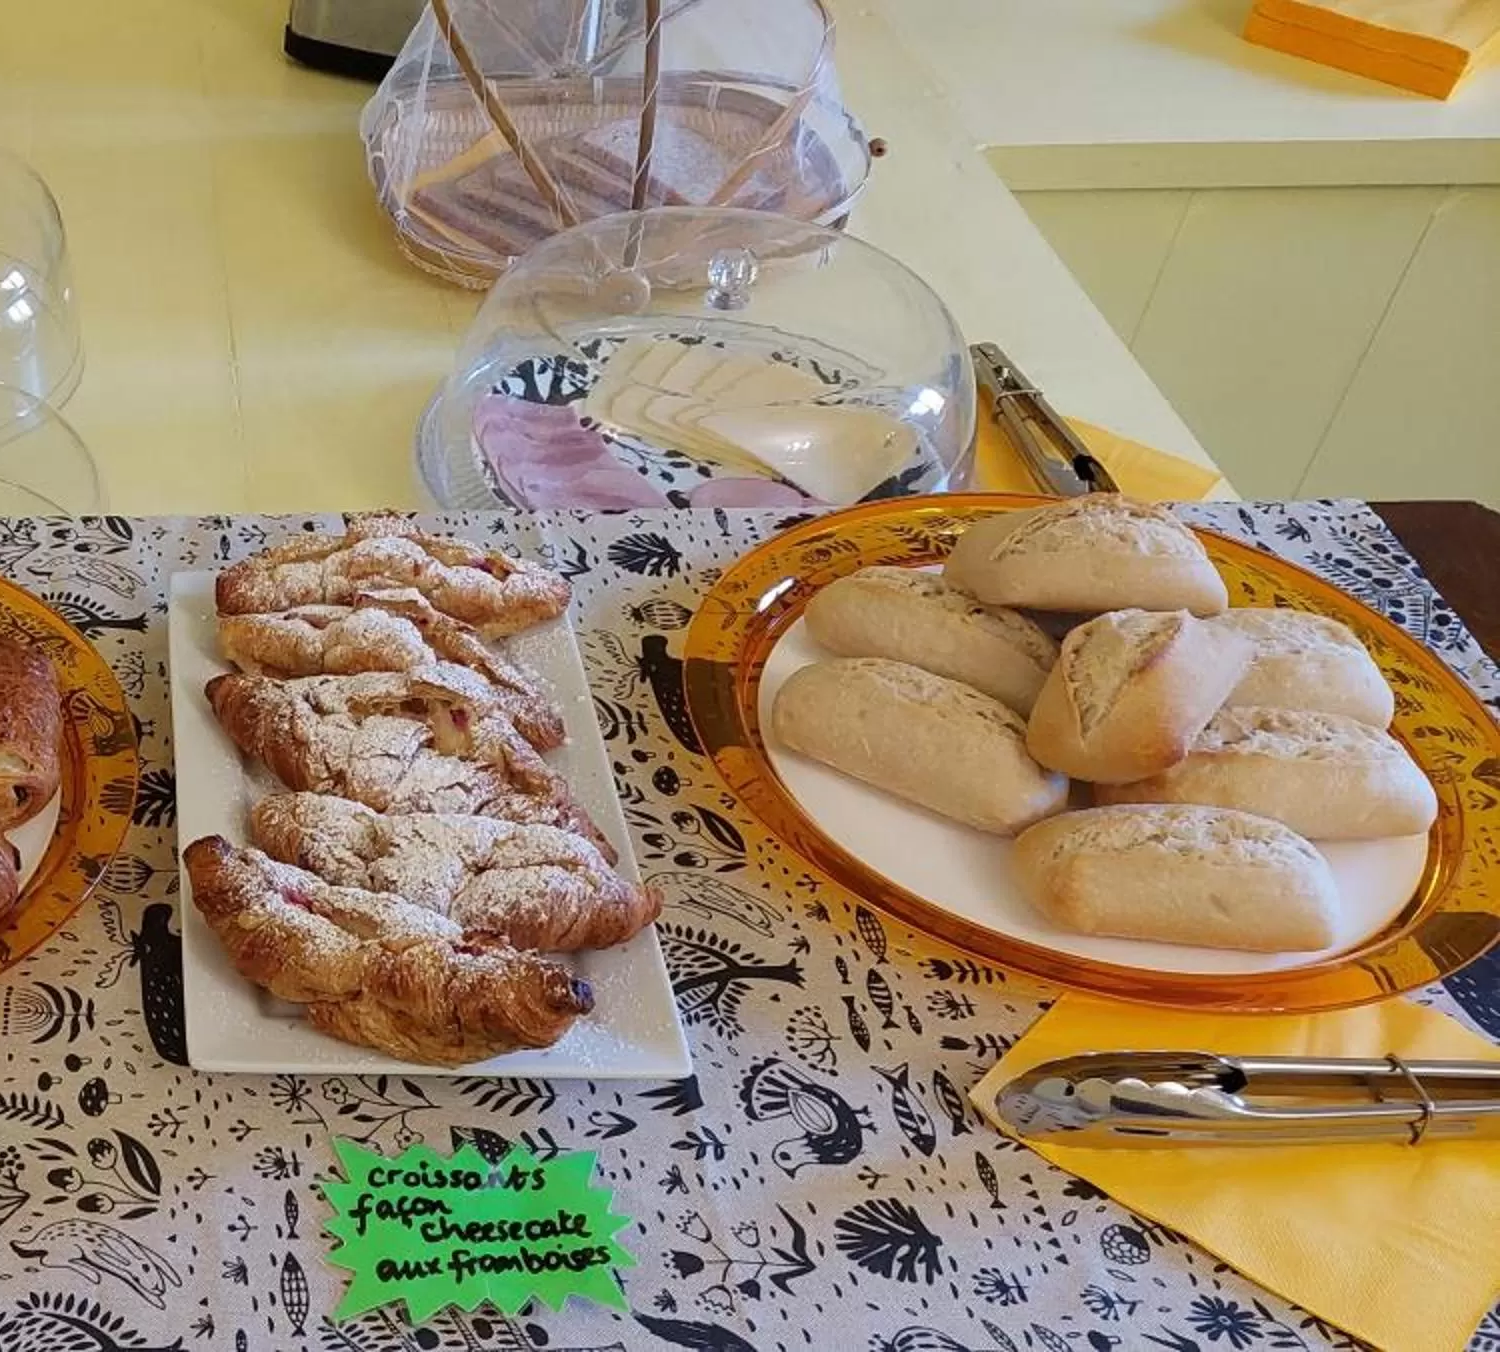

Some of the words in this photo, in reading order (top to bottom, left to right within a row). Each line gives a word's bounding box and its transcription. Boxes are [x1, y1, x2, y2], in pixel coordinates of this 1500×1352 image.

[347, 1193, 453, 1237] façon
[375, 1257, 443, 1283] aux
[447, 1244, 612, 1285] framboises
